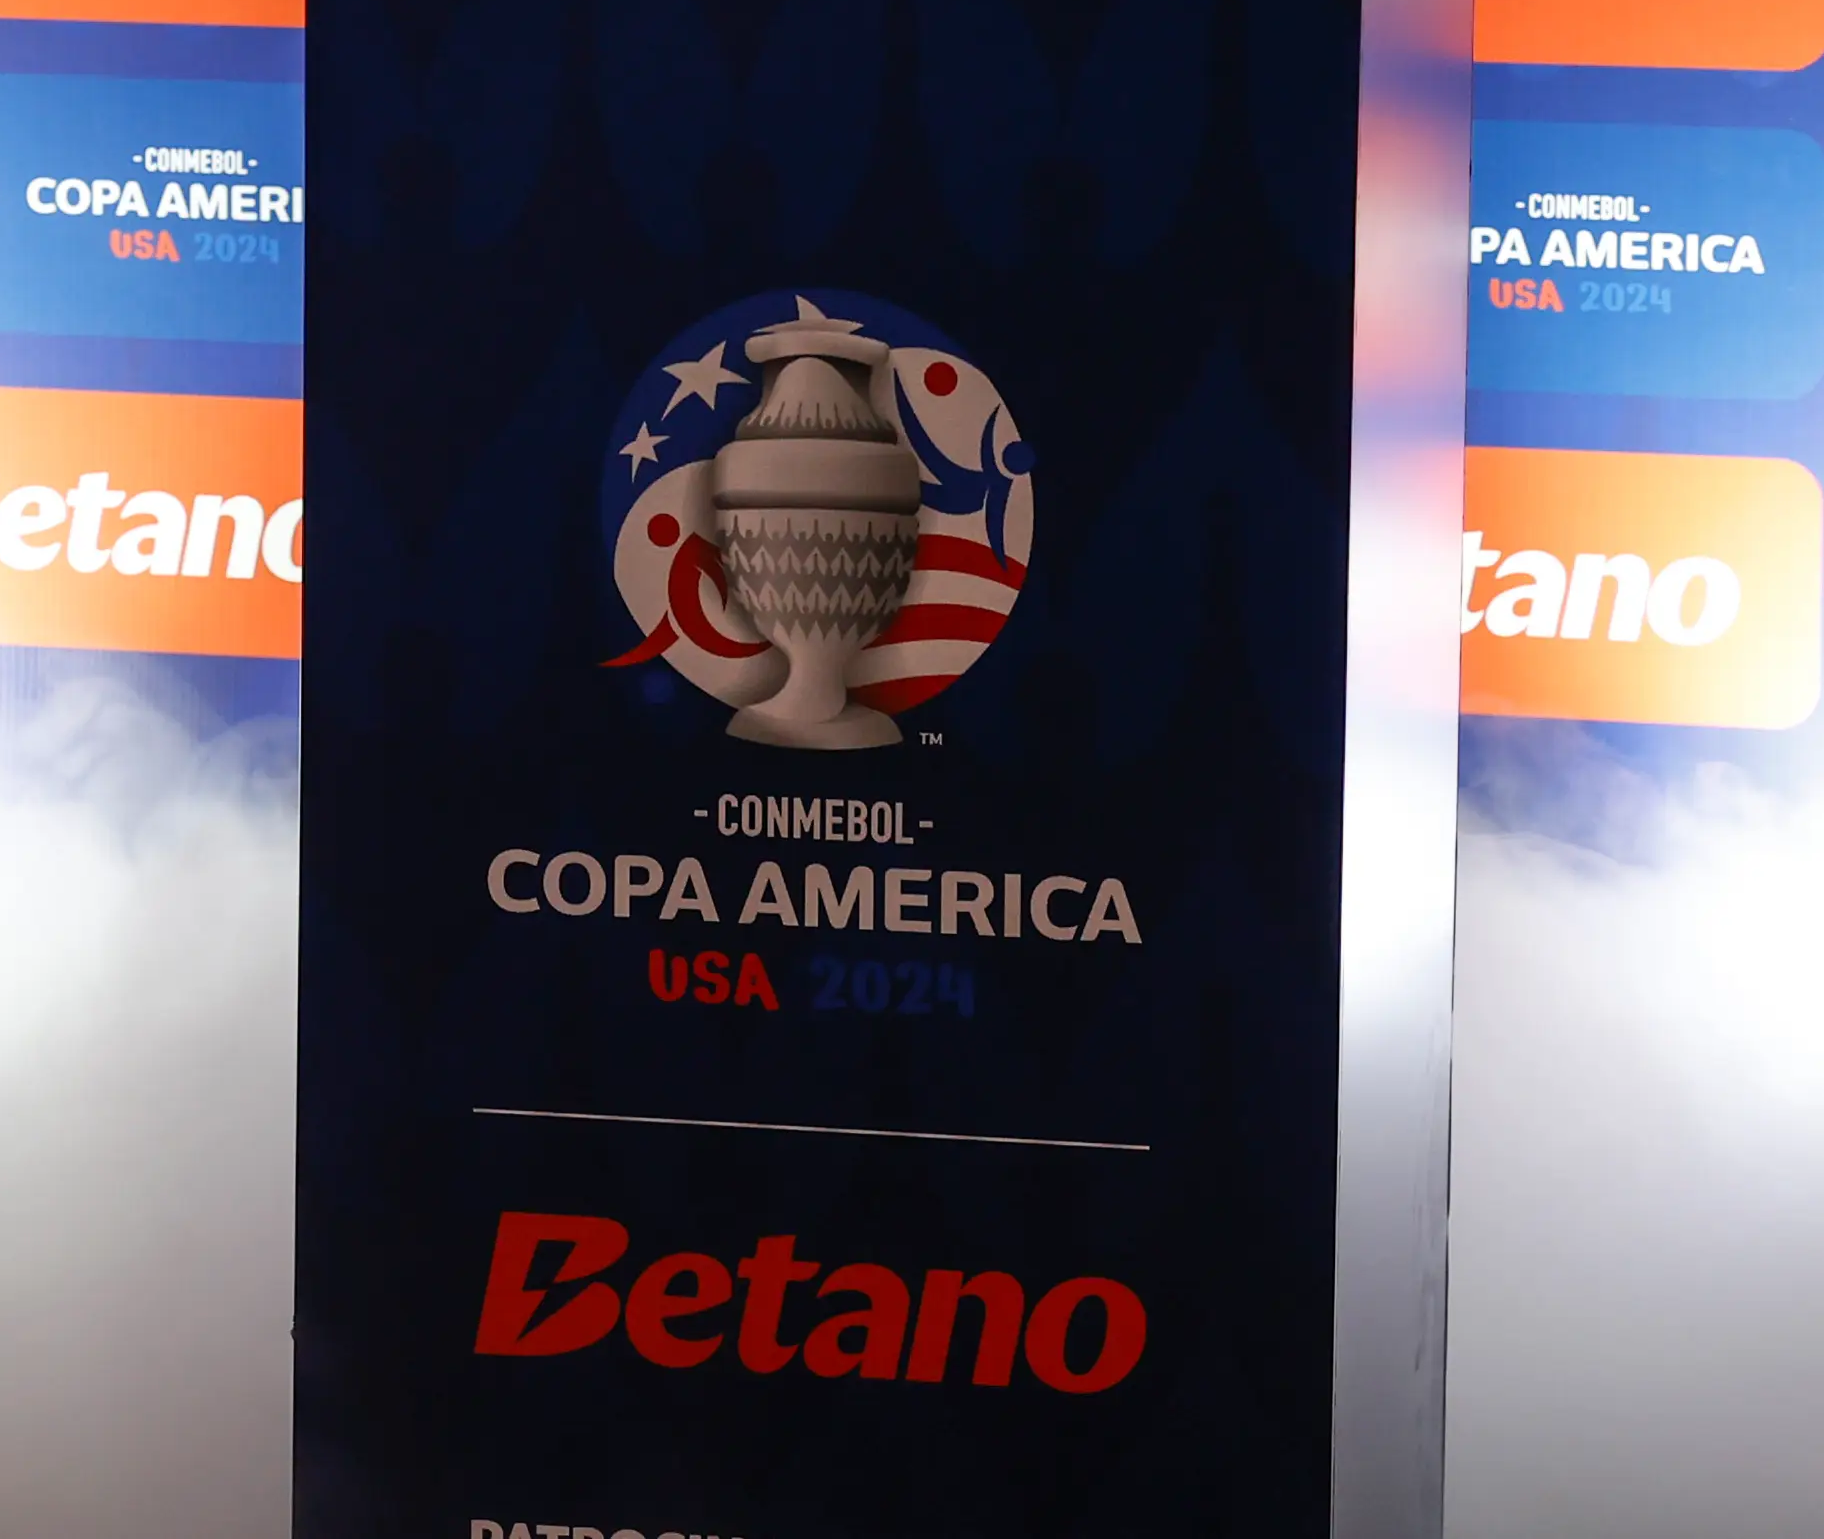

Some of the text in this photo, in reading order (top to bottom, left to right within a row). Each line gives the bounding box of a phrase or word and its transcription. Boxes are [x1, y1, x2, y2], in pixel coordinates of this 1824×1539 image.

[26, 177, 302, 222] COPA AMERI
[112, 231, 278, 262] USA 2024
[1472, 227, 1765, 274] PA AMERICA
[1491, 280, 1671, 314] USA 2024
[1461, 531, 1741, 647] tano
[487, 849, 1143, 945] COPA AMERICA
[648, 948, 975, 1018] USA 2024
[474, 1210, 1149, 1394] Betano
